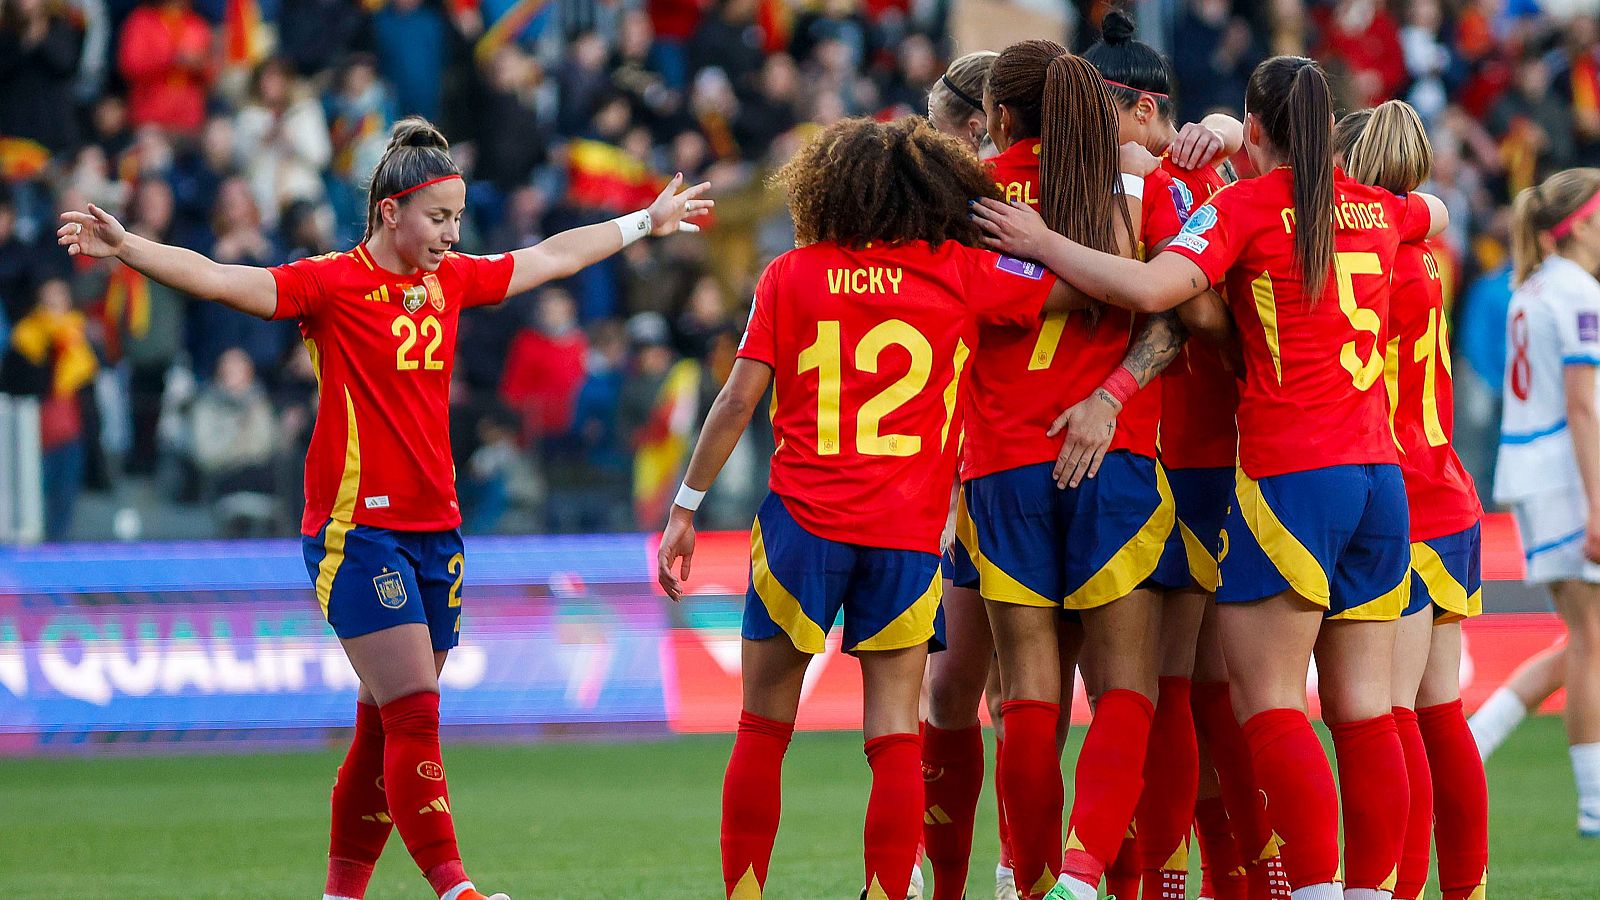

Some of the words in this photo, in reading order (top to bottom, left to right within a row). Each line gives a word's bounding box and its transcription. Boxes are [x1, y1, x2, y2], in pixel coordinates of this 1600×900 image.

[1281, 195, 1389, 234] MÉNDEZ
[828, 267, 903, 294] VICKY
[391, 315, 444, 370] 22
[1334, 252, 1385, 392] 5
[1511, 309, 1532, 402] 8
[798, 319, 933, 456] 12
